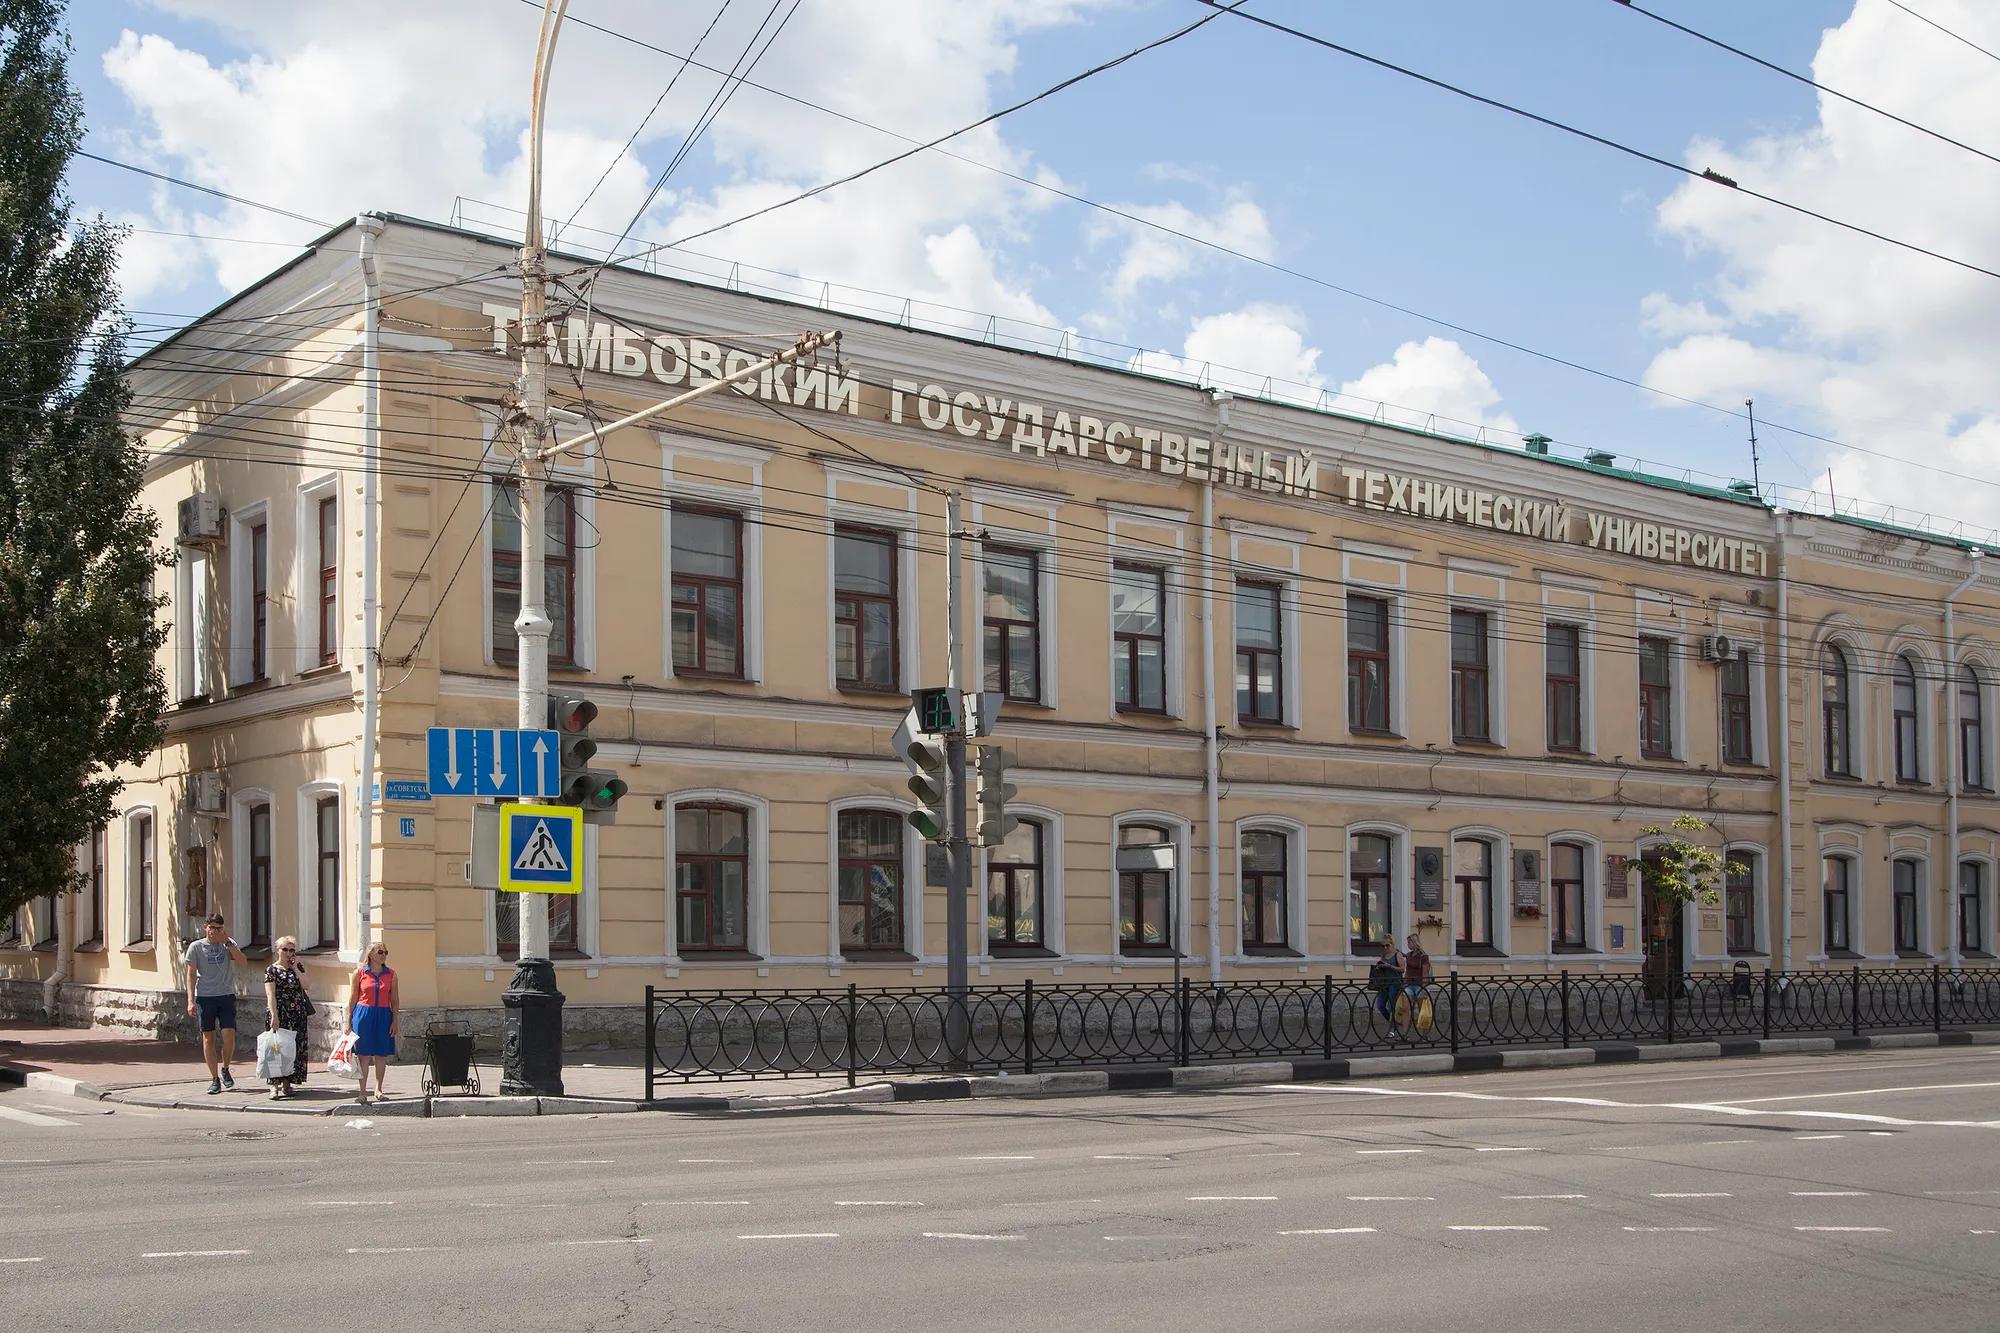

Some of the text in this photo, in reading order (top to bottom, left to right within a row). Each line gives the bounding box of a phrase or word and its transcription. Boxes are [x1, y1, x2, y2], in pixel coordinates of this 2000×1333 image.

[890, 378, 1318, 499] ГОСУДАРСТВЕННЫЙ
[1341, 466, 1571, 543] ТЕХНИЧЕСКИЙ
[1587, 512, 1768, 577] УНИВЕРСИТЕТ
